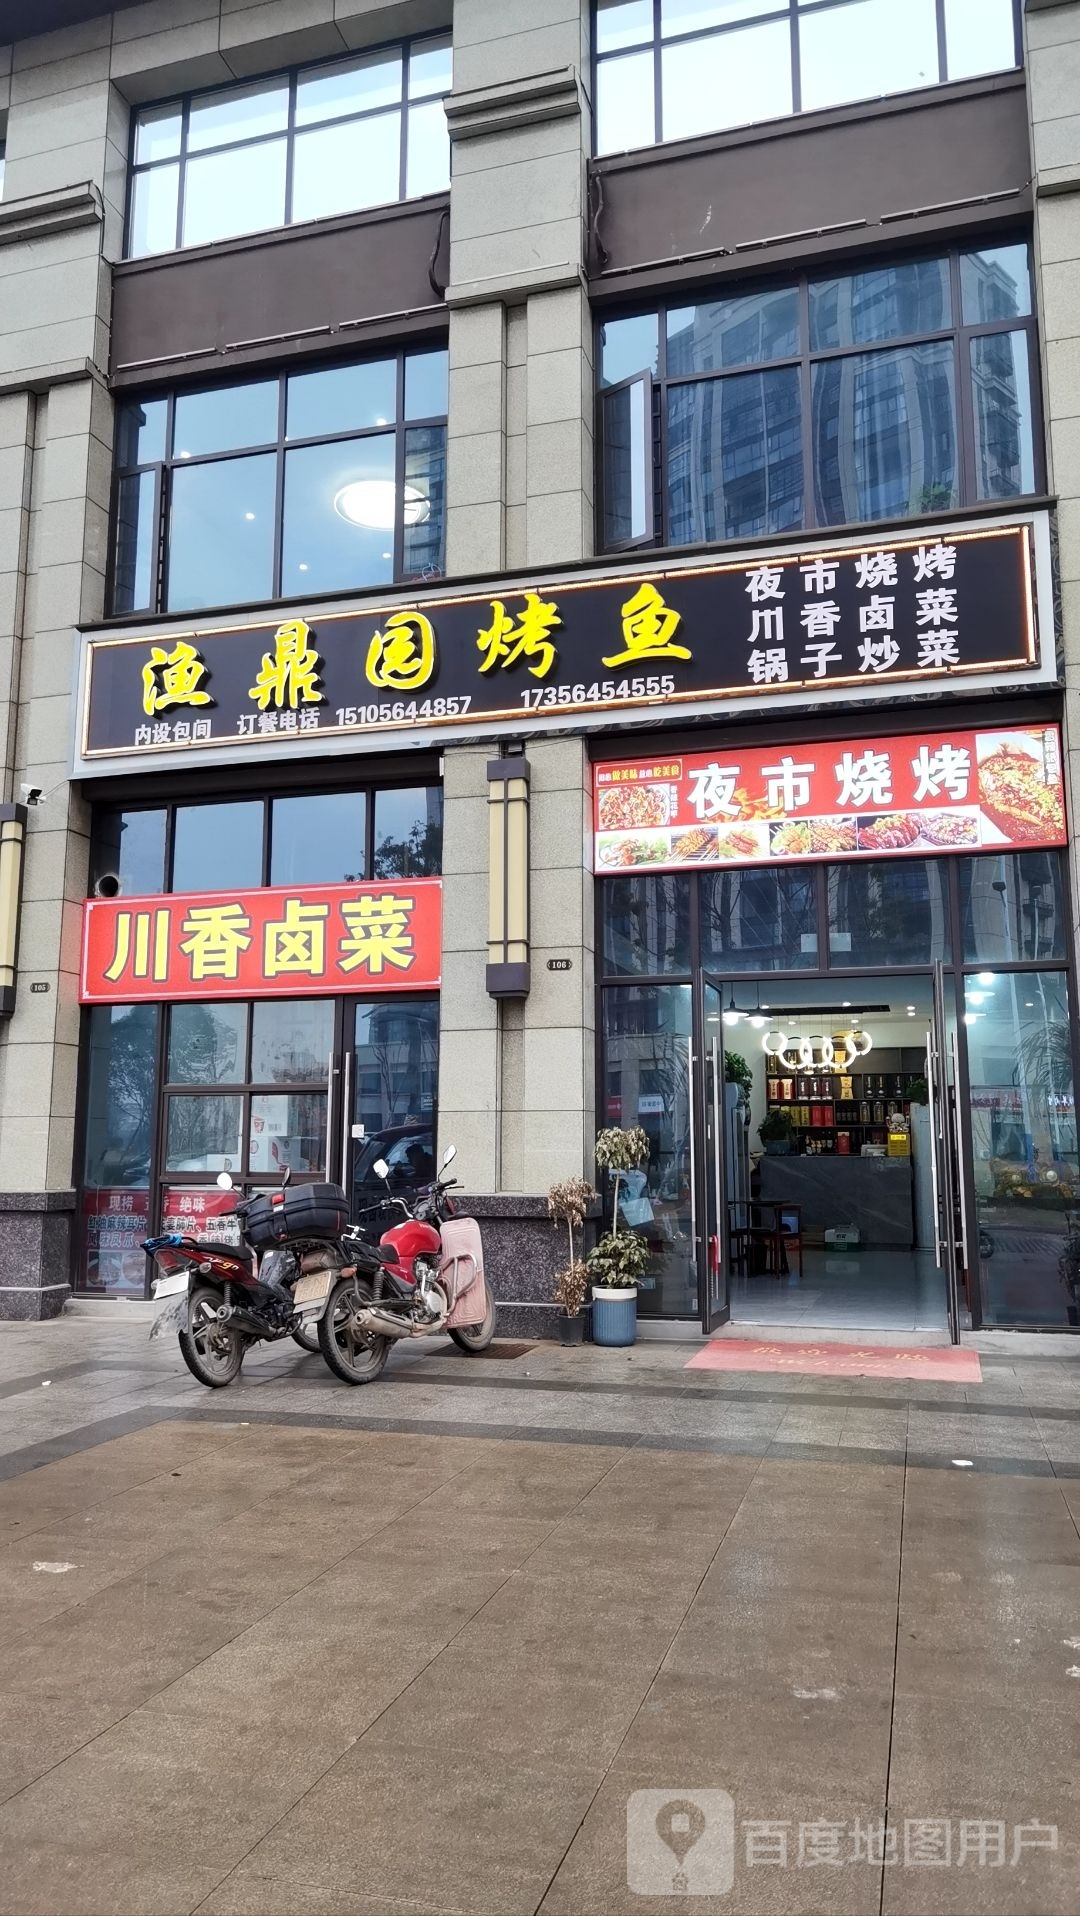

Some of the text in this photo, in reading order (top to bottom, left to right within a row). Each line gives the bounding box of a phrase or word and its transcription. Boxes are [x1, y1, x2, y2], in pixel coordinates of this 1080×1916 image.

[744, 545, 958, 601] 夜市烧烤
[747, 588, 960, 643] 川香卤菜
[747, 629, 961, 684] 锅子炒菜
[520, 675, 675, 708] 17356454555
[134, 696, 472, 746] 内设包间 订餐电话 15105644857
[687, 743, 972, 818] 夜市烧烤
[103, 893, 416, 983] 川香卤菜
[33, 984, 47, 992] 105
[551, 961, 568, 969] 106
[179, 1196, 206, 1213] 绝味
